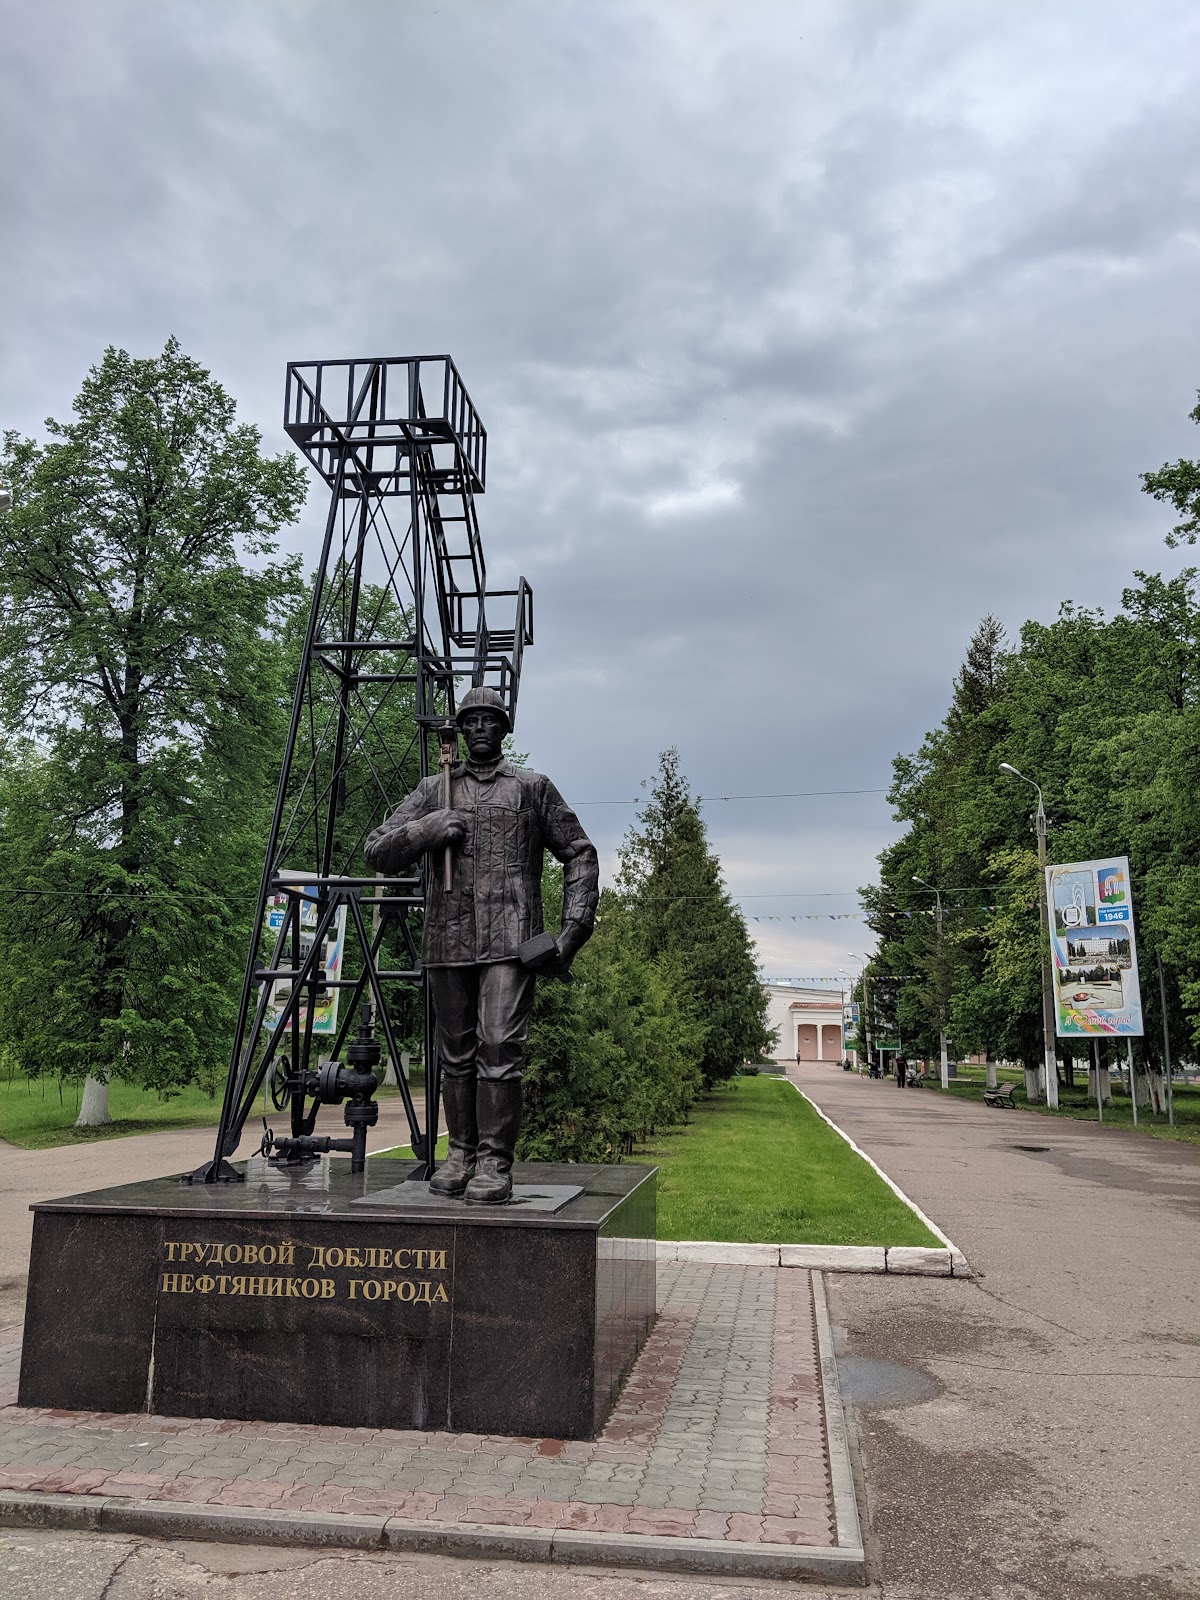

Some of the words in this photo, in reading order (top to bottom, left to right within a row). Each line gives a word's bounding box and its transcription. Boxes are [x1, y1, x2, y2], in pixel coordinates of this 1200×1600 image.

[1104, 911, 1124, 921] 1946
[1088, 1014, 1107, 1025] мой
[1108, 1013, 1133, 1028] город
[164, 1241, 297, 1268] ТРУДОВОЙ
[307, 1246, 448, 1271] ДОБЛЕСТИ
[161, 1273, 336, 1298] НЕФТЯНИКОВ
[347, 1279, 449, 1307] ГОРОДА
